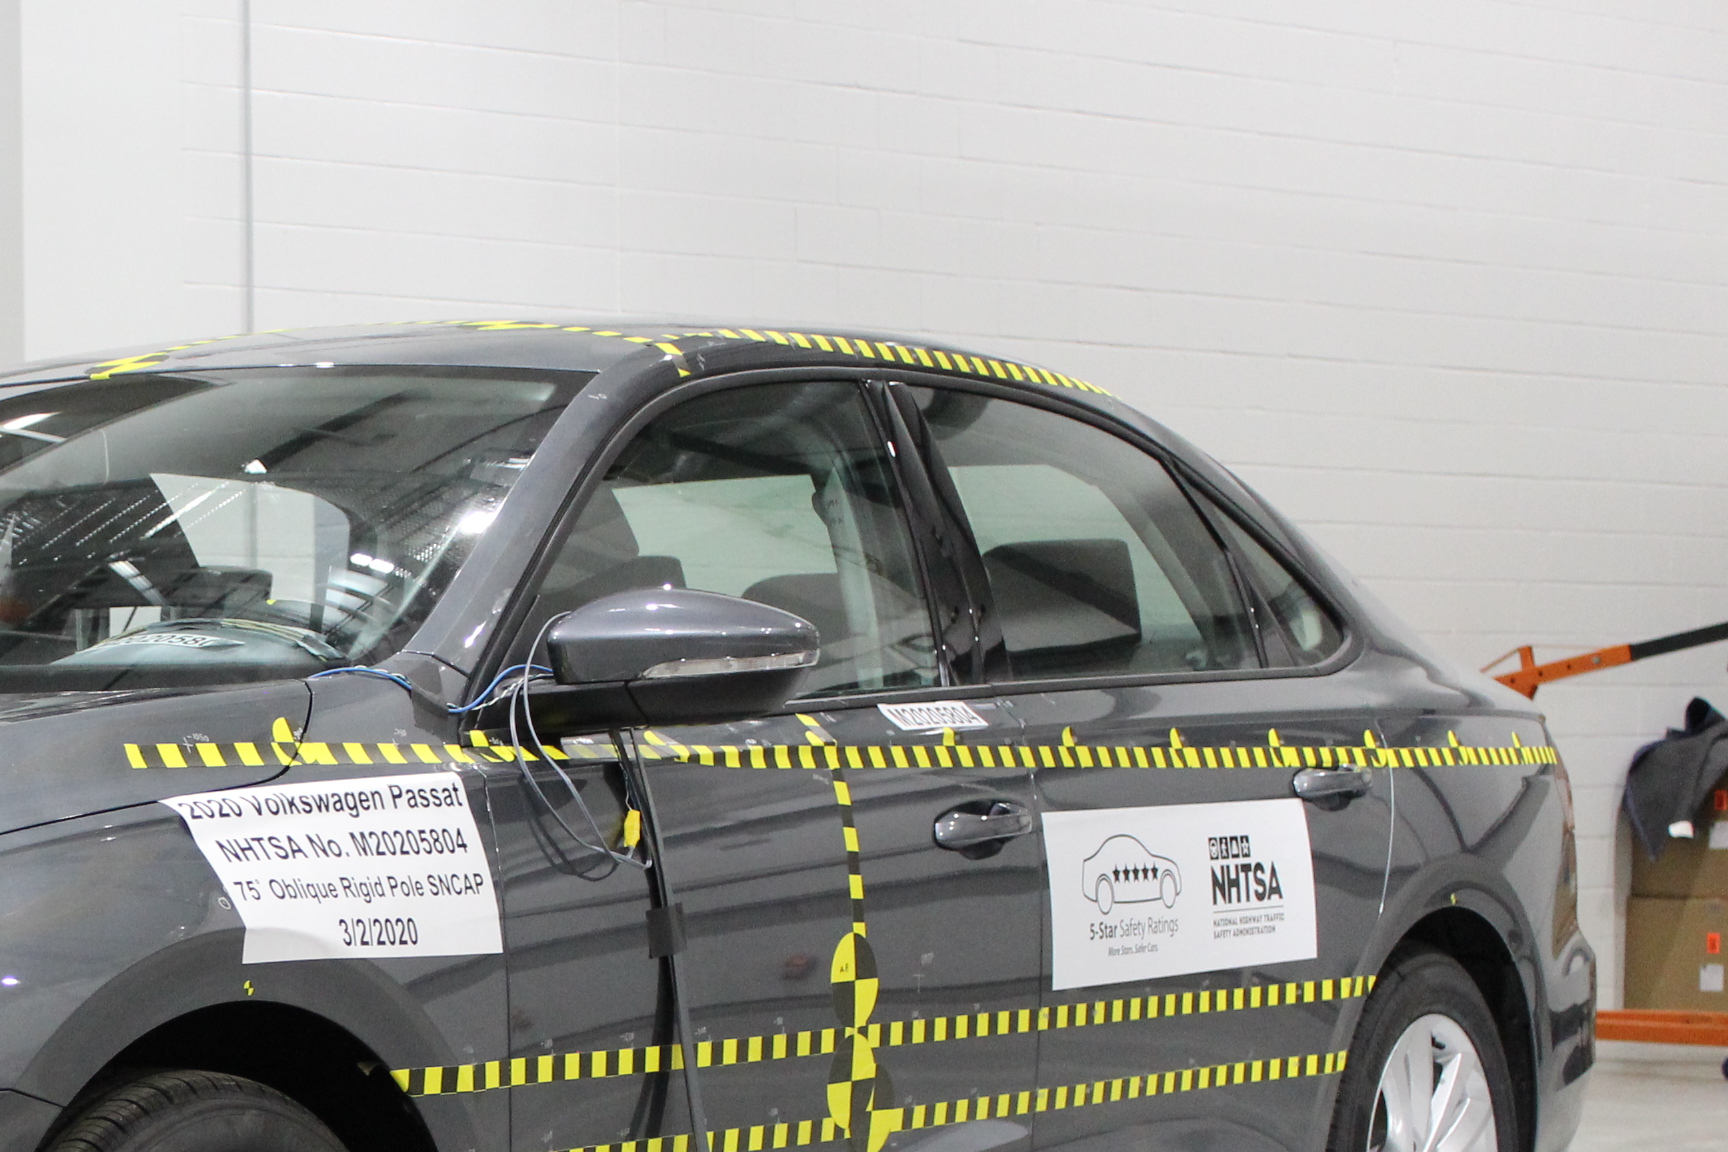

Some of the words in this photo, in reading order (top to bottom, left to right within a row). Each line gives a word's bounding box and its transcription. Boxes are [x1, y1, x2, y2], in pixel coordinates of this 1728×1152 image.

[177, 797, 243, 820] 2020
[239, 790, 385, 818] Volkswagen
[388, 783, 464, 808] Passat
[215, 835, 308, 863] NHTSA
[305, 833, 350, 859] No.
[349, 828, 468, 857] M20205804
[269, 878, 339, 904] Oblique
[339, 876, 386, 903] Rigid
[388, 875, 425, 898] Pole
[425, 873, 485, 896] SNCAP
[1210, 861, 1284, 906] NHTSA
[339, 917, 419, 946] 3/2/2020
[1089, 921, 1118, 941] 5-Star
[1119, 917, 1146, 940] Safety
[1147, 915, 1179, 938] Ratings
